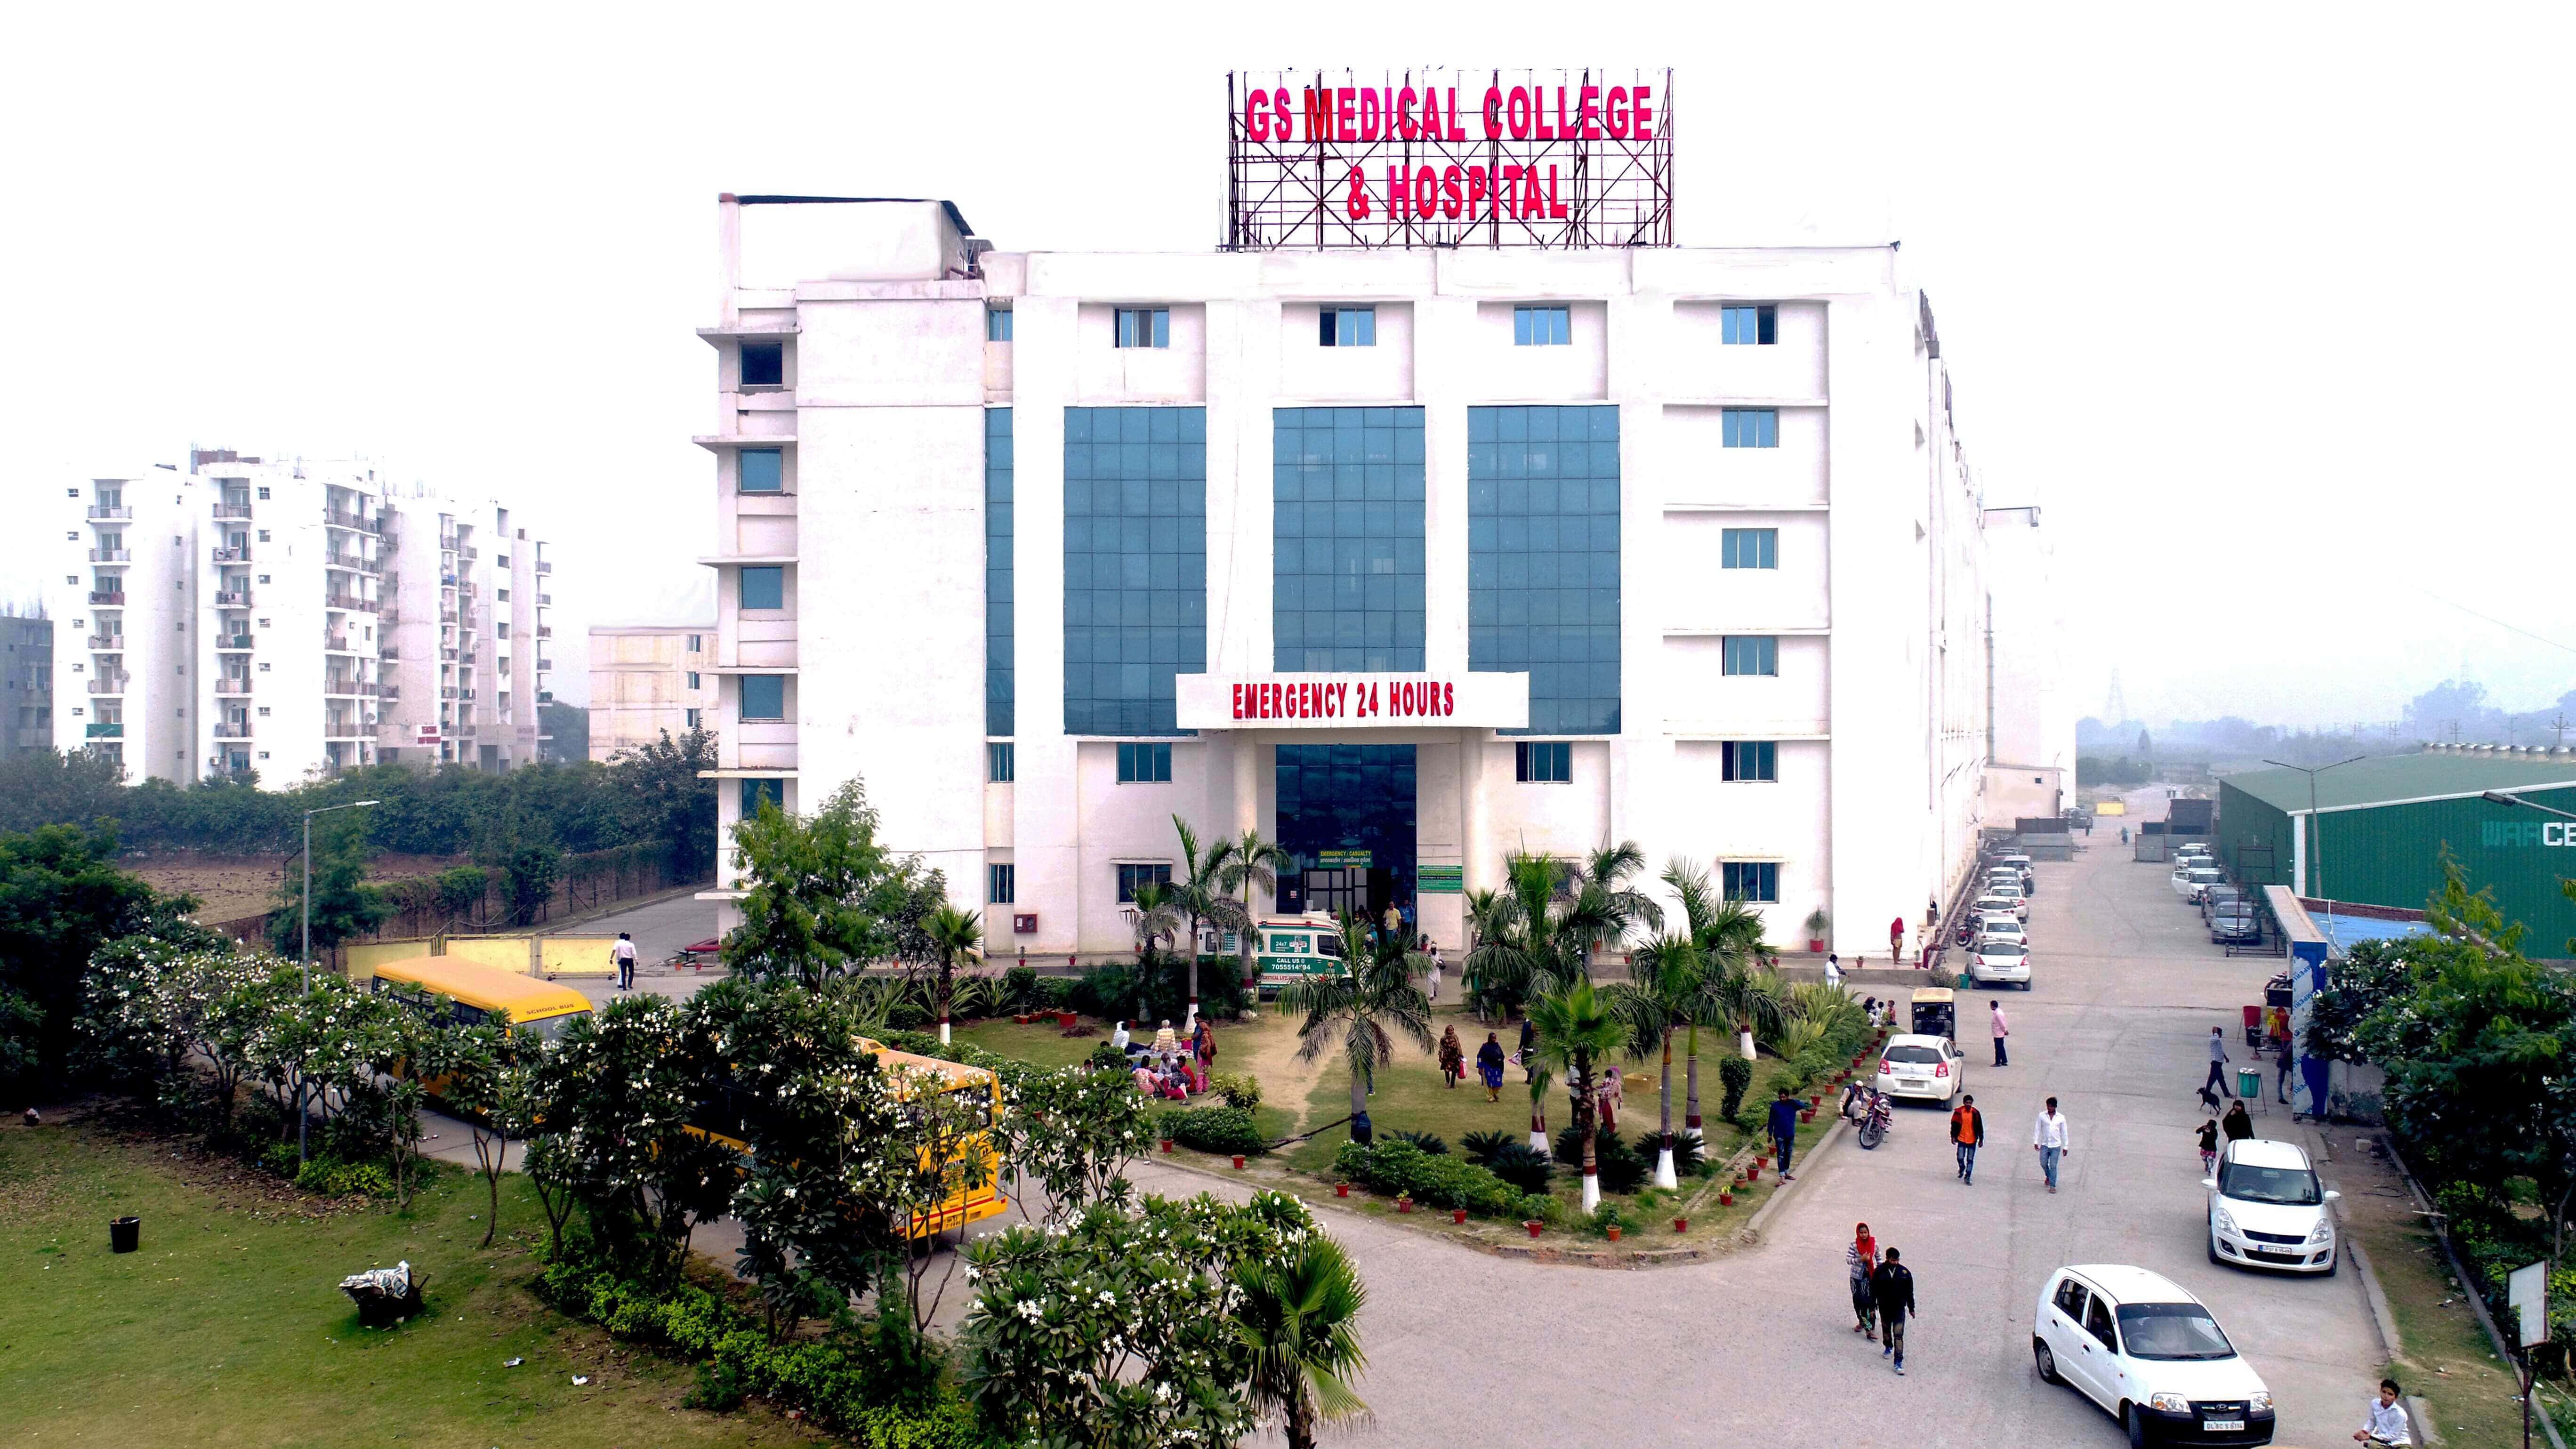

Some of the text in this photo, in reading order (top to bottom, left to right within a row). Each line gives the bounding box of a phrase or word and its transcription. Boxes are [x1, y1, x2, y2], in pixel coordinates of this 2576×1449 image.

[1246, 85, 1652, 143] GS MEDICAL COLLEGE
[1347, 164, 1568, 220] & HOSPITAL
[1232, 682, 1454, 718] EMERGENCY 24 HOURS
[526, 1006, 558, 1015] SCHOOL
